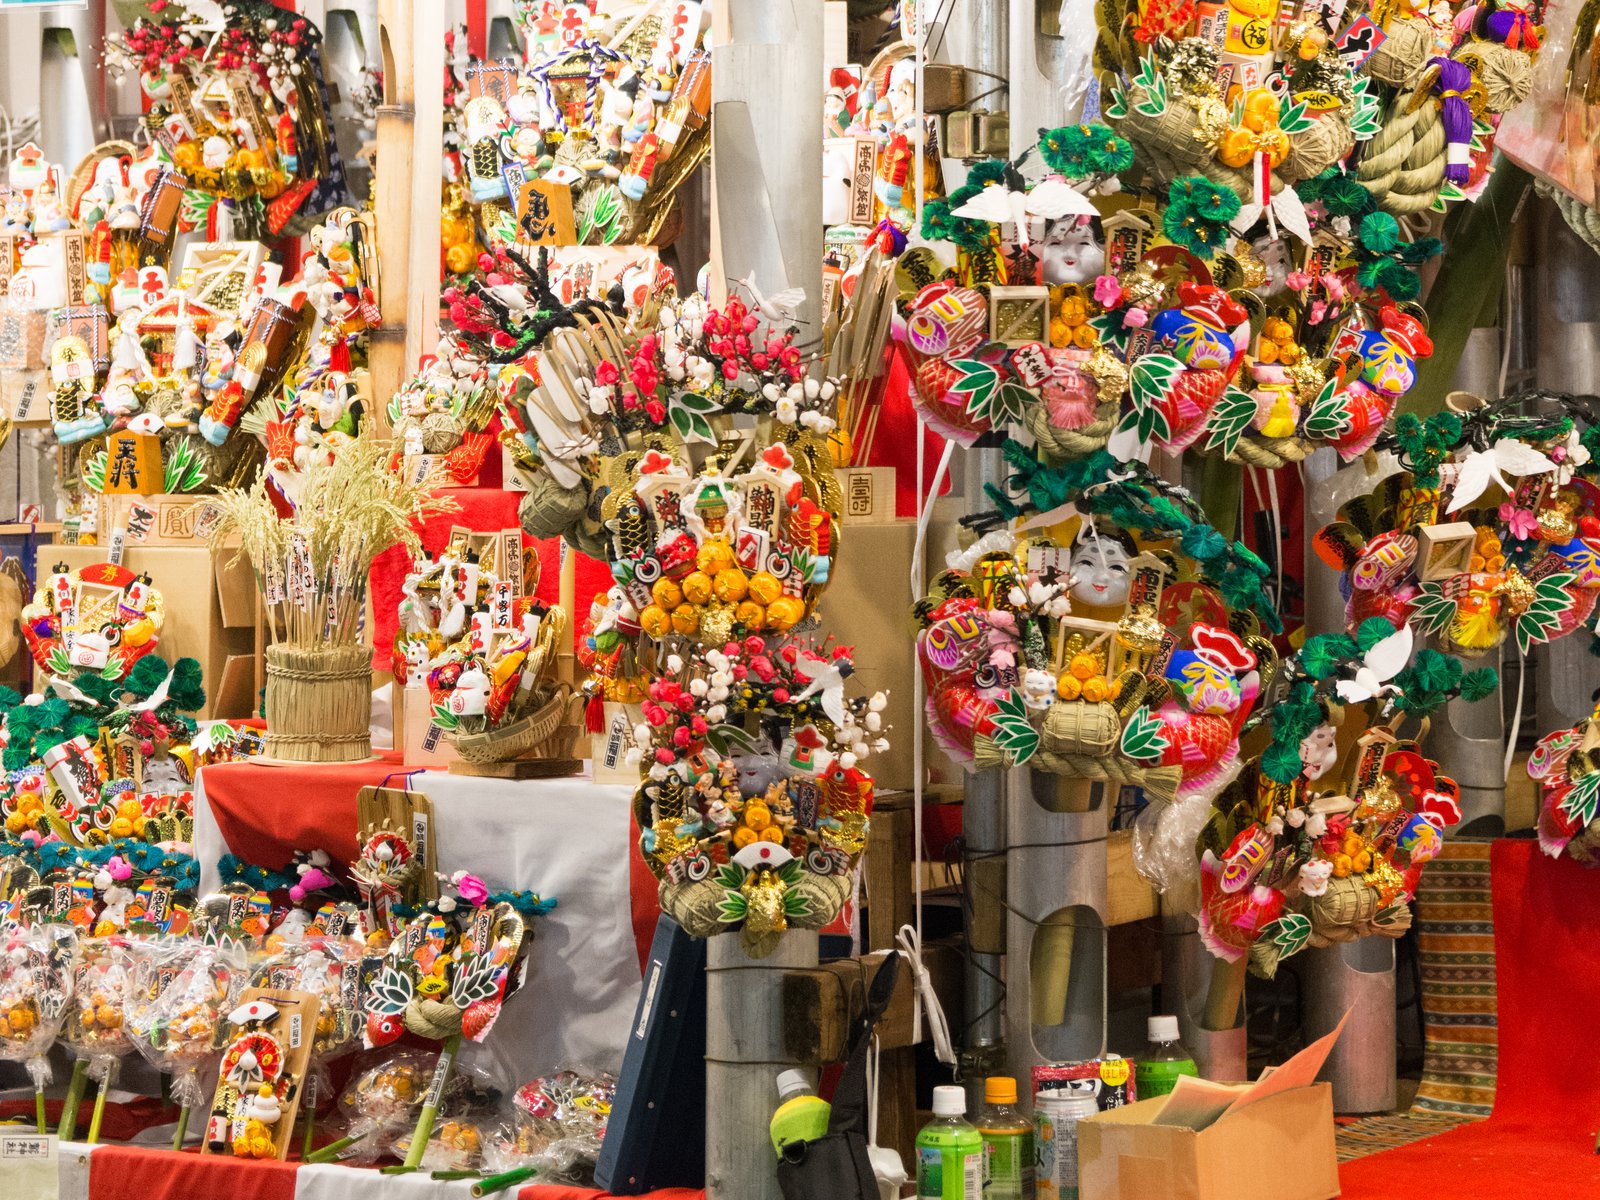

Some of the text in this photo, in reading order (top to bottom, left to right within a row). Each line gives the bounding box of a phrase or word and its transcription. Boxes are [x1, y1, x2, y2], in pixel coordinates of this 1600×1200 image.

[1244, 22, 1267, 47] 福
[109, 439, 141, 490] 王将
[852, 476, 871, 512] 壽
[100, 564, 119, 582] 寿
[498, 585, 509, 627] 千客万
